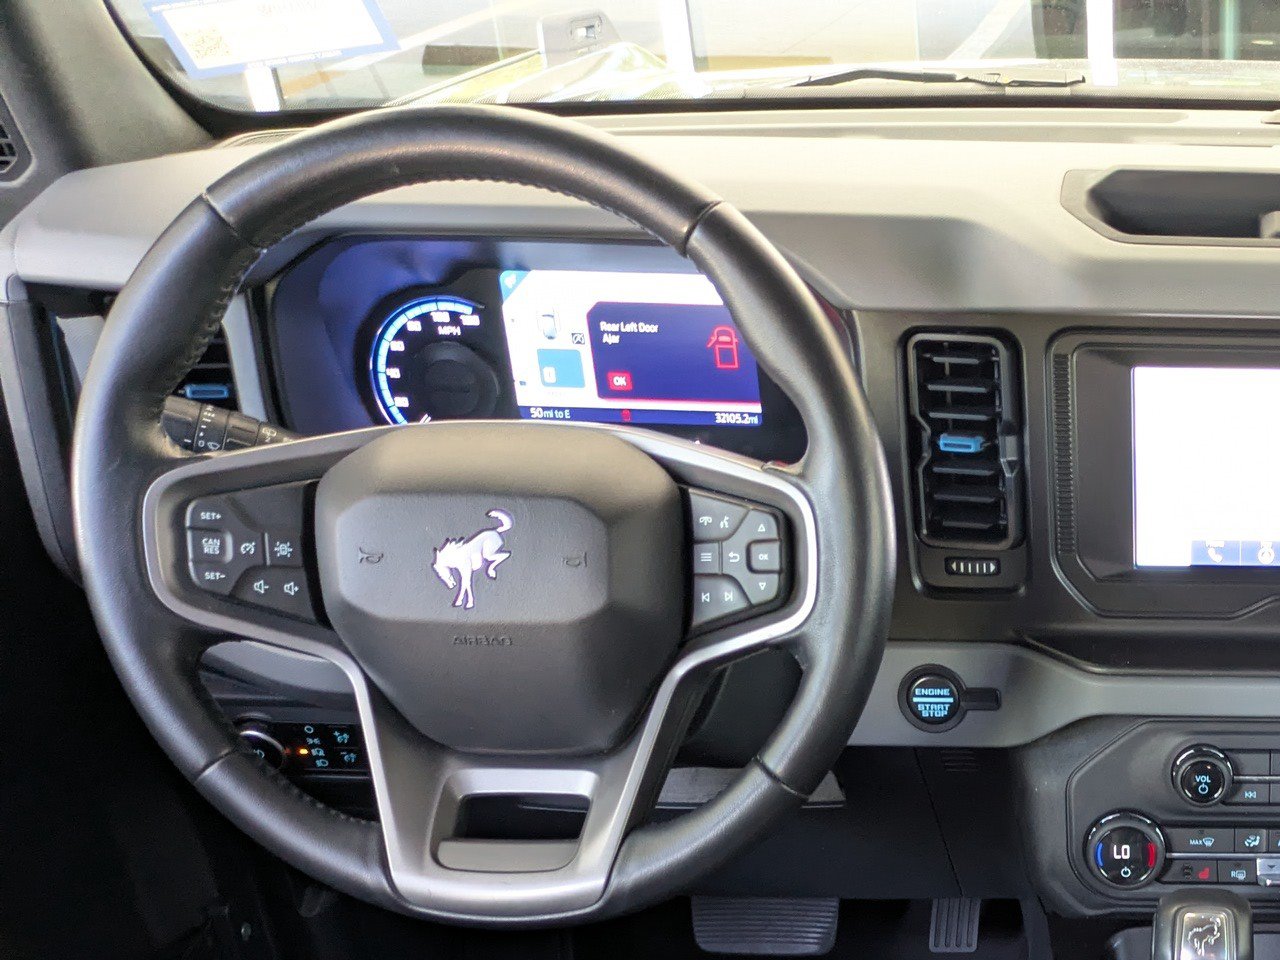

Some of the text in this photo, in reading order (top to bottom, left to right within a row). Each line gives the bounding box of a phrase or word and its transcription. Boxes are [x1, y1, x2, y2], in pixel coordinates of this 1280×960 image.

[437, 325, 461, 336] MPH
[600, 321, 659, 333] Rear Left Door
[603, 333, 620, 345] Ajar
[613, 376, 627, 387] OK
[554, 409, 564, 419] to
[564, 409, 571, 419] E
[200, 511, 222, 520] SET+
[202, 537, 220, 546] CAN
[203, 546, 220, 555] RES
[758, 553, 769, 561] OK
[204, 572, 226, 580] SET-
[915, 688, 950, 696] ENGINE
[917, 703, 951, 711] START
[921, 710, 948, 718] STOP
[1195, 775, 1211, 783] VOL
[1189, 838, 1203, 846] MAX
[1113, 844, 1131, 860] LO
